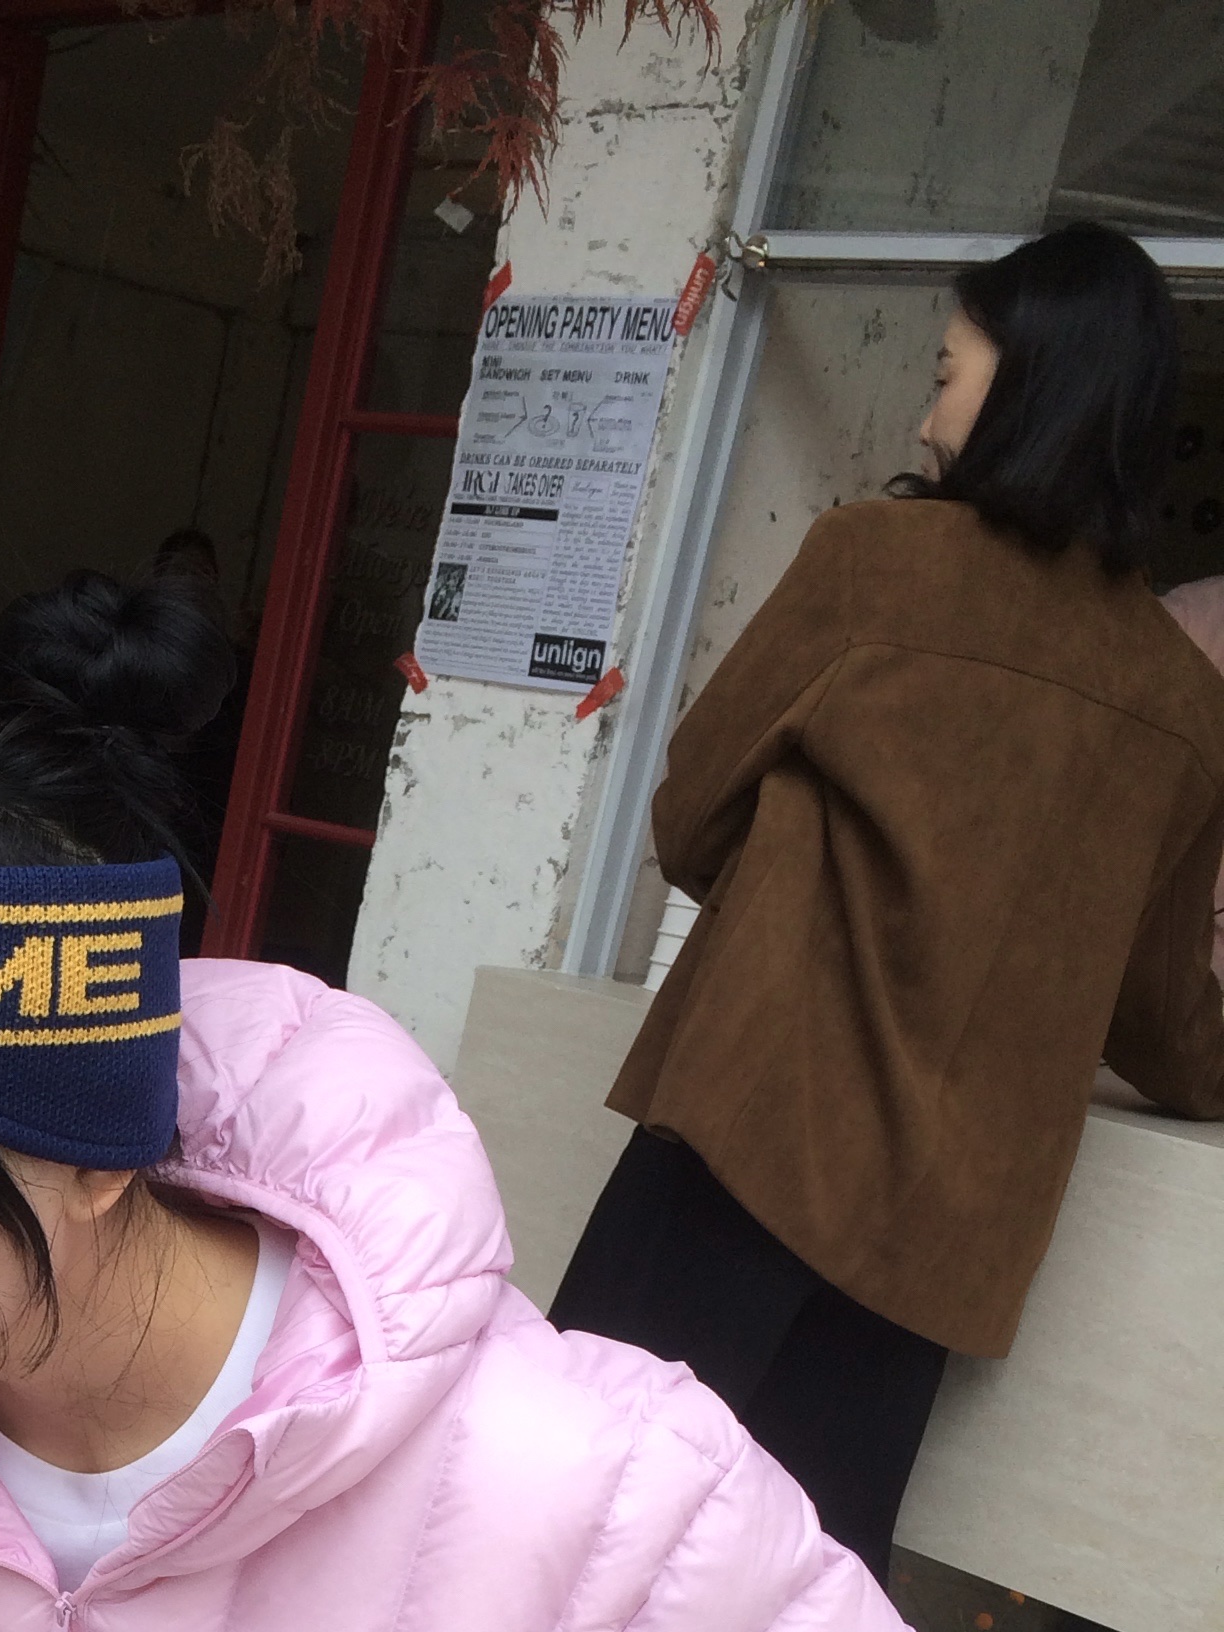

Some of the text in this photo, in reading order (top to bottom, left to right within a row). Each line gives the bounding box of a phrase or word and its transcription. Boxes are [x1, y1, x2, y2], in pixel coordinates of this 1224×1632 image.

[676, 267, 708, 326] unlign
[485, 304, 677, 342] OPENING PARTY MENU
[479, 368, 650, 385] SANDWICH SET MENU DRINK
[460, 452, 643, 475] DRINKS CAN BE ORDERED SEPARATELY
[504, 472, 537, 497] TAKES
[537, 474, 565, 498] OVER
[534, 639, 601, 673] unlign
